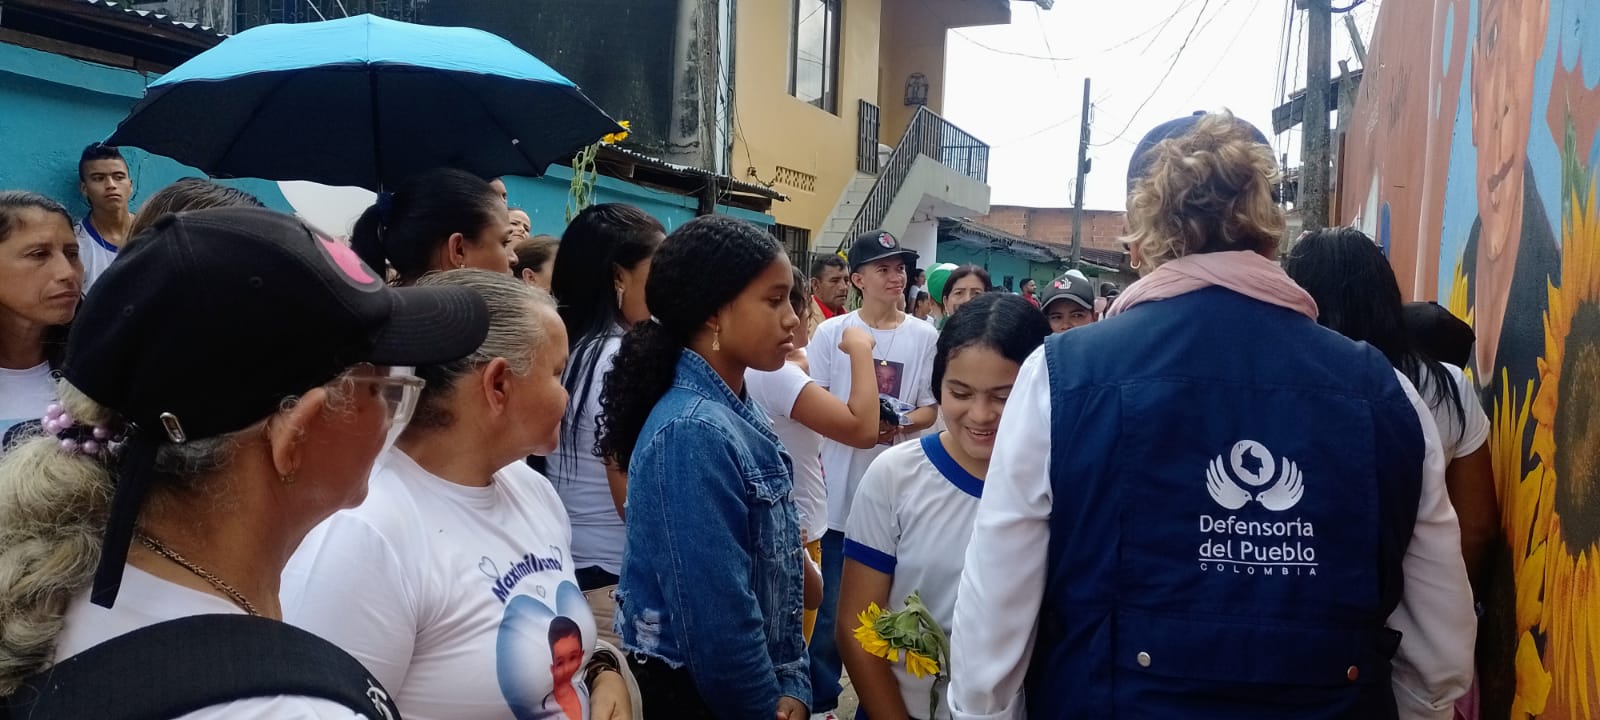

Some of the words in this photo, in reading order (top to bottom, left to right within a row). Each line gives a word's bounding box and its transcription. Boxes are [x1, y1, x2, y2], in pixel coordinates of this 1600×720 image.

[1200, 515, 1314, 537] Defensoría
[1199, 538, 1232, 558] del
[1241, 541, 1315, 561] Pueblo
[1200, 563, 1316, 576] COLOMBIA
